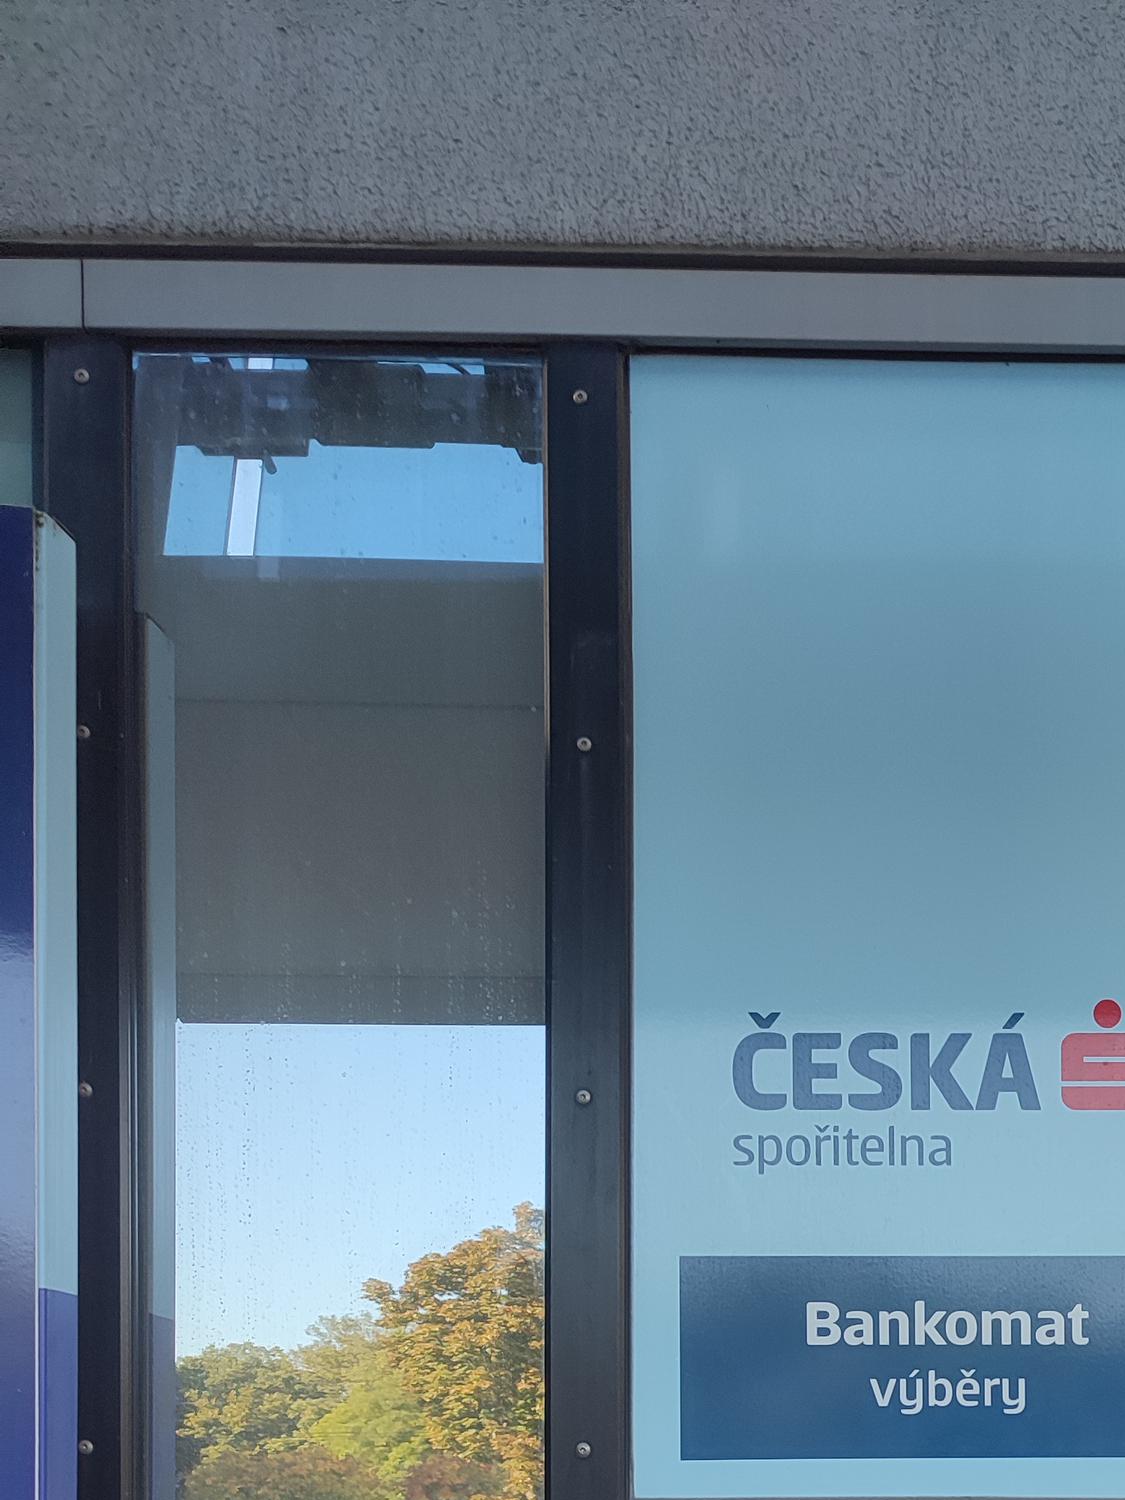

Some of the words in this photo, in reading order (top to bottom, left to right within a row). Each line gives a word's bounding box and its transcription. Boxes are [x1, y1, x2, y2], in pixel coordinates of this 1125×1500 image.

[732, 1011, 1041, 1111] ČESKÁ
[732, 1125, 952, 1175] spořitelna
[806, 1300, 1090, 1346] Bankomat
[869, 1368, 1026, 1415] výběry
